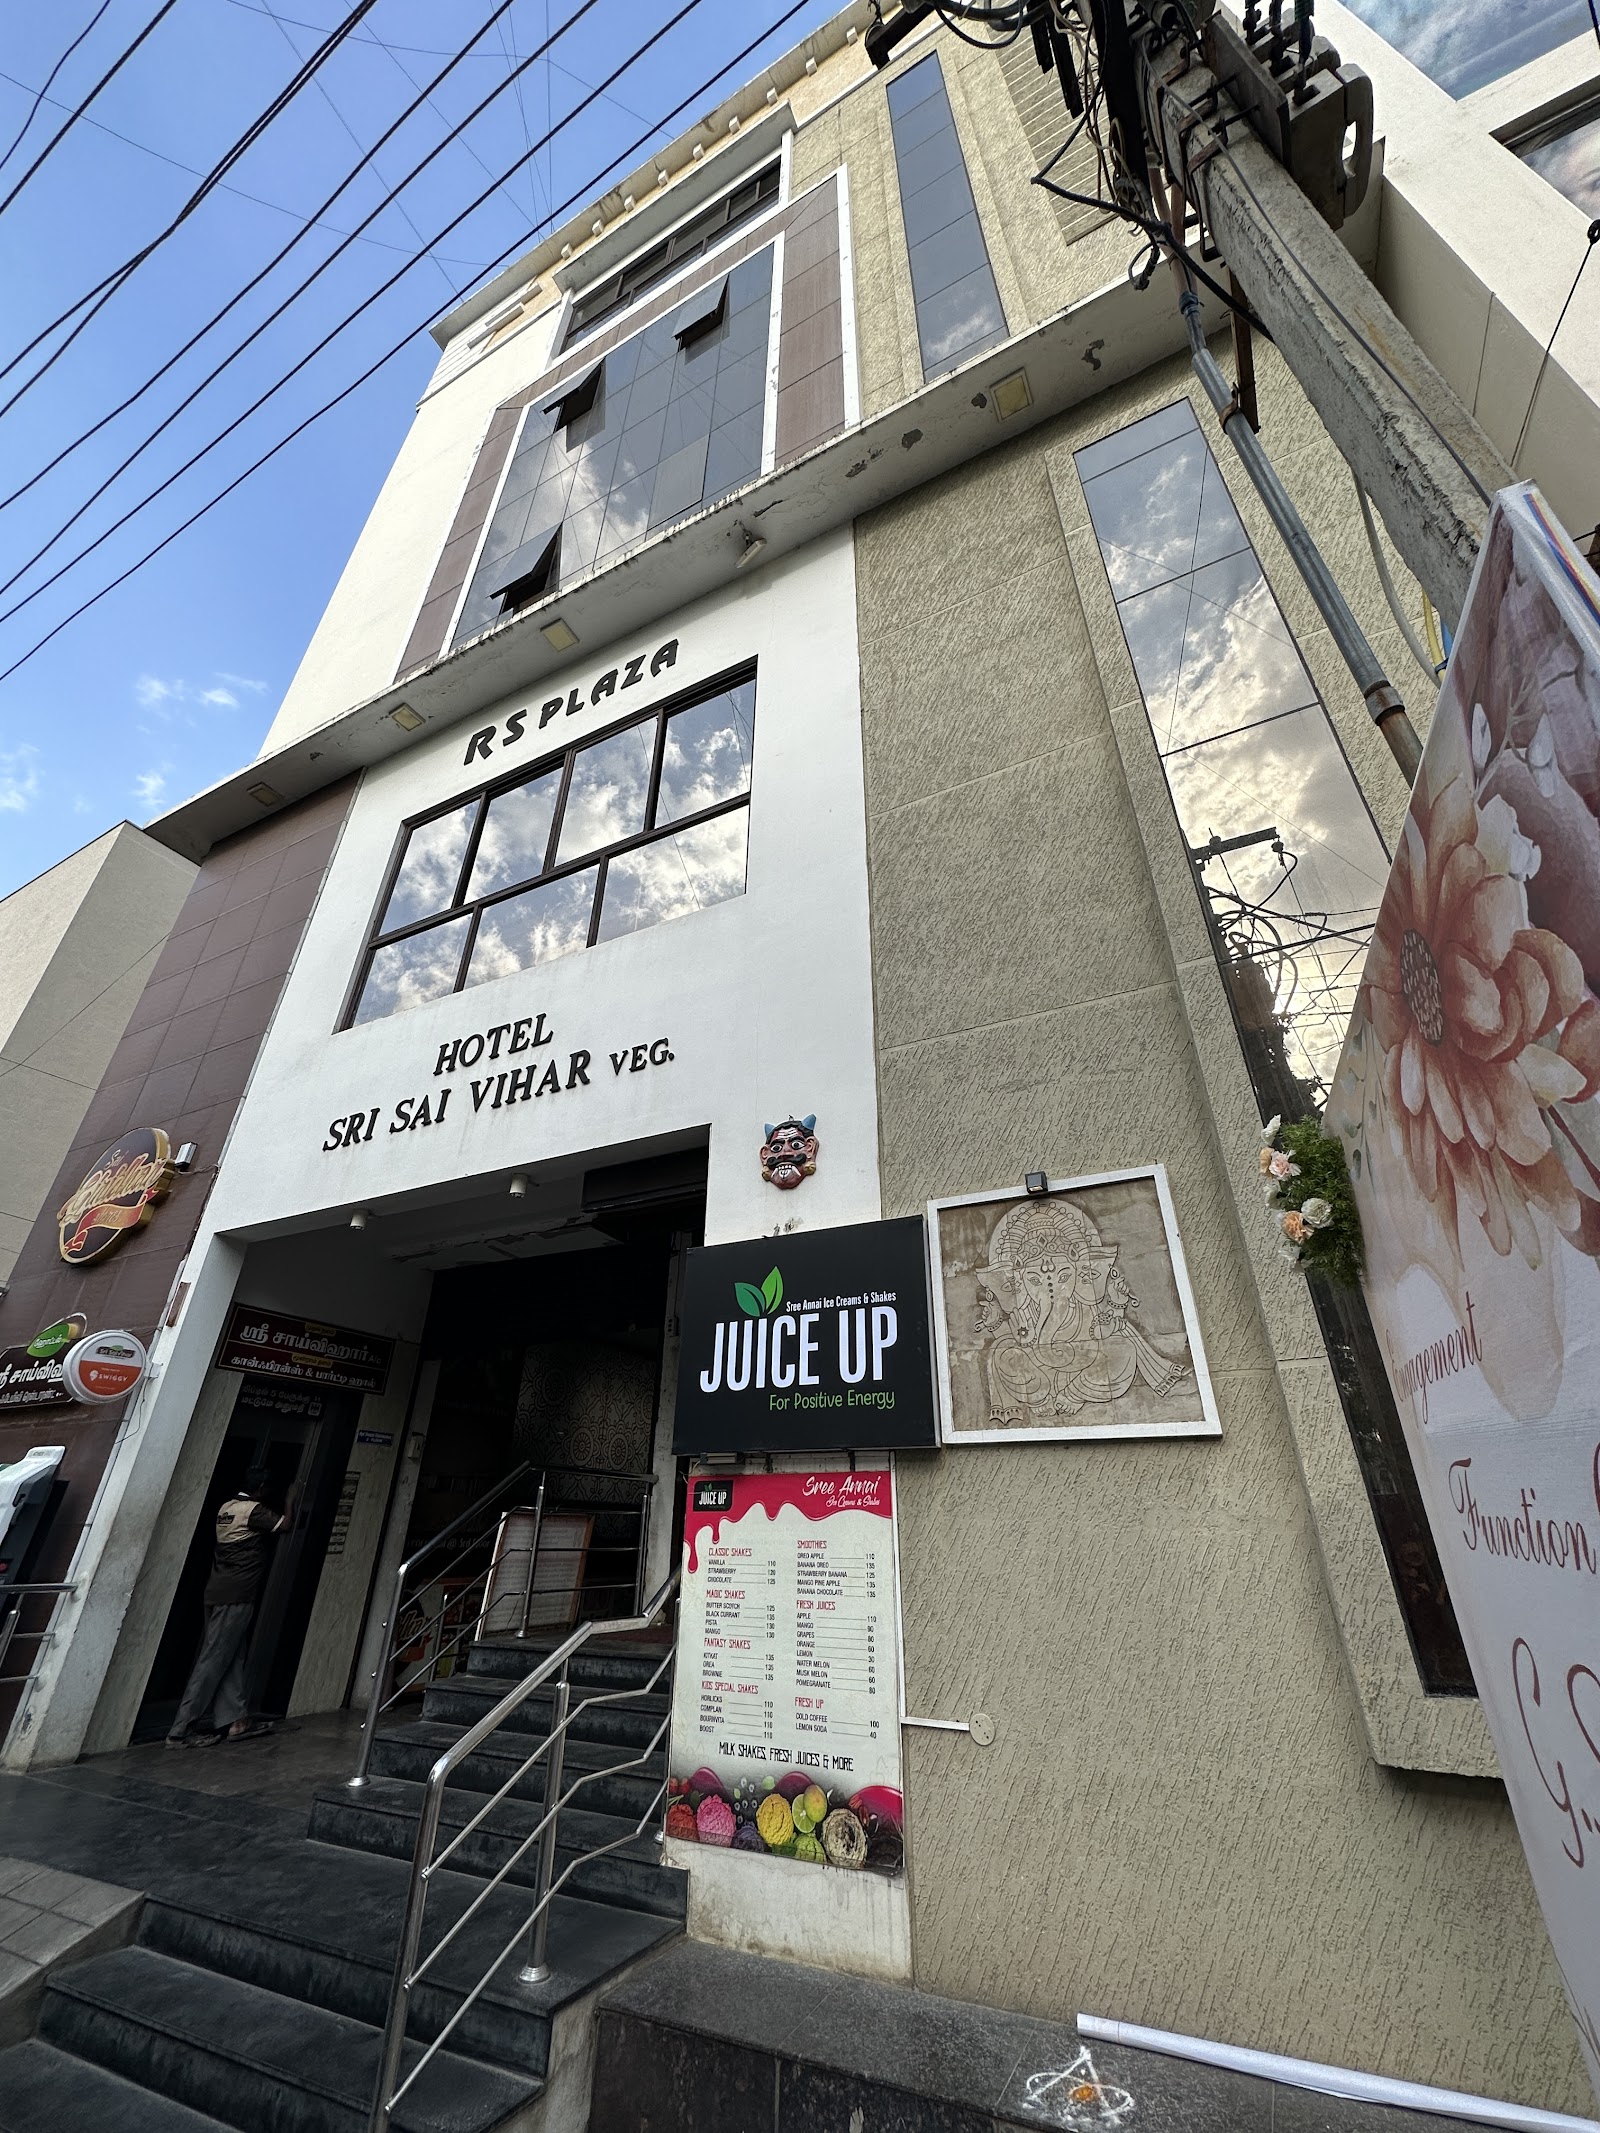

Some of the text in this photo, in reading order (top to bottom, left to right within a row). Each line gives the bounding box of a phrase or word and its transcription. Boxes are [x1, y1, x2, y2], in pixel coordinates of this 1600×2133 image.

[539, 638, 680, 730] PLAZA
[432, 1012, 554, 1077] HOTEL
[322, 1037, 675, 1152] SRI SAI VIHAR VEG.
[786, 1291, 897, 1312] Sree Annai Ice Creams & Shakes
[700, 1305, 898, 1393] JUICE UP
[98, 1373, 129, 1382] SWIGGY
[305, 1368, 313, 1377] &
[770, 1389, 895, 1411] For Positive Energy
[802, 1475, 882, 1497] Sree Annai
[699, 1491, 728, 1505] JUICE UP
[1449, 1457, 1597, 1575] Function
[797, 1540, 827, 1549] SMOOTHIES
[709, 1548, 752, 1557] CLASSIC SHAKES
[706, 1589, 745, 1599] MAGIC SHAKES
[797, 1600, 835, 1611] FRESH JUICES
[704, 1638, 750, 1649] FANTASY SHAKES
[796, 1640, 815, 1648] ORANGE
[703, 1652, 718, 1660] KITKAT
[813, 1661, 830, 1669] MELON
[702, 1669, 722, 1677] BROWNIE
[796, 1669, 810, 1677] MUSK
[810, 1670, 828, 1678] MELON
[702, 1680, 758, 1694] KIDS SPECIAL SHAKES
[796, 1679, 831, 1689] POMEGRANATE
[701, 1695, 722, 1703] HORLICKS
[795, 1697, 824, 1709] FRESH UP
[700, 1704, 722, 1713] COMPLAN
[700, 1715, 773, 1729] BOURNVITA 110
[796, 1712, 808, 1721] COLD
[809, 1714, 828, 1722] COFFEE
[700, 1724, 714, 1733] BOOST
[796, 1723, 877, 1739] LEMON SODA 40
[719, 1742, 735, 1756] MILK
[769, 1748, 793, 1763] FRESH
[796, 1751, 820, 1767] JUICES
[823, 1754, 829, 1769] &
[832, 1756, 854, 1771] MORE
